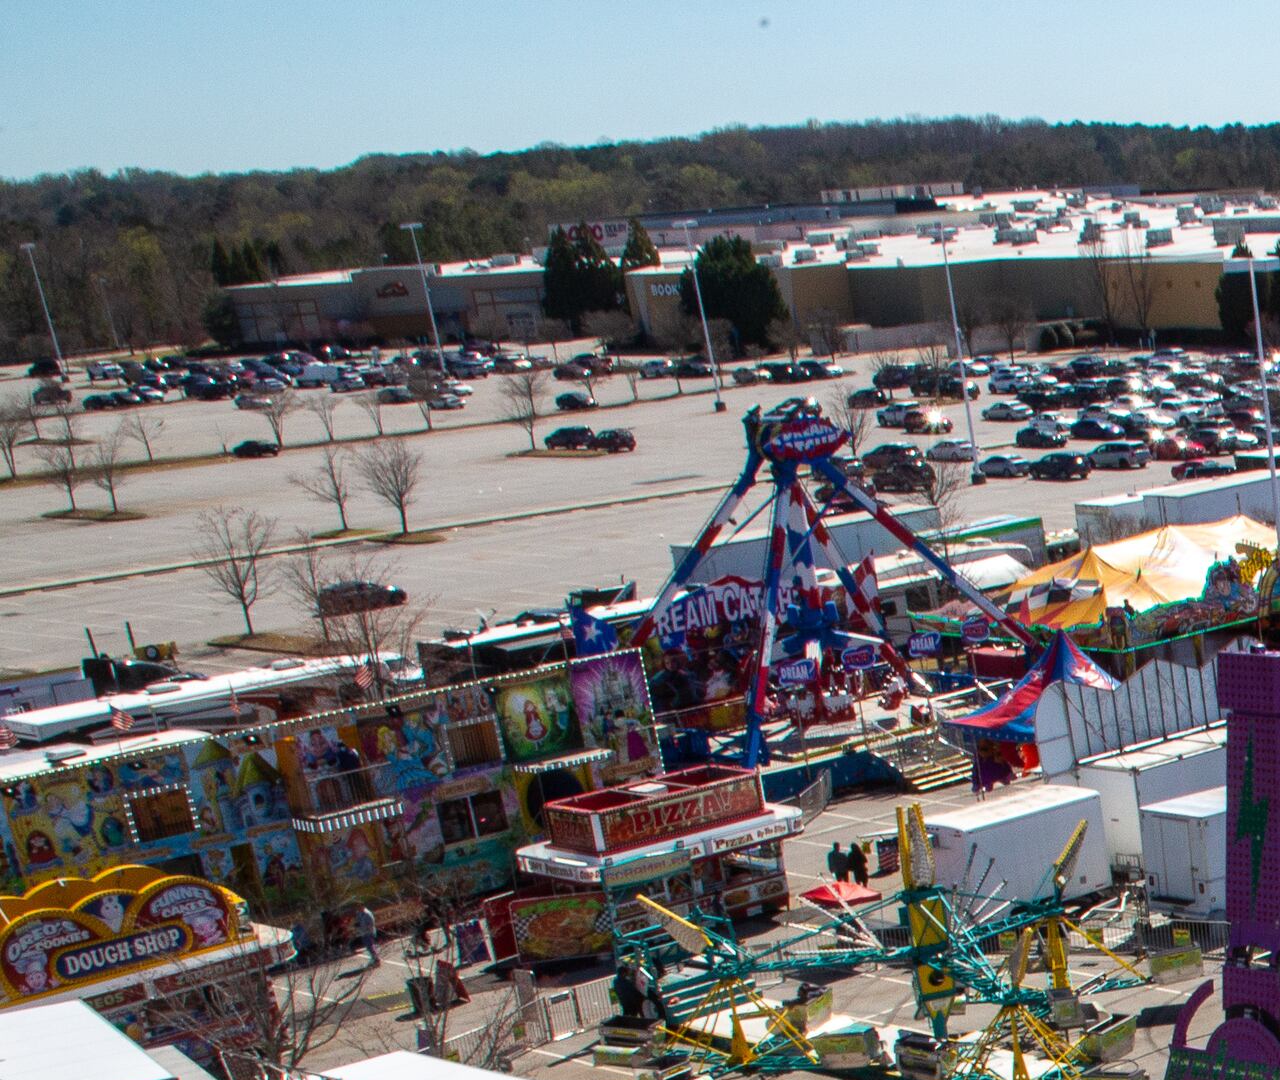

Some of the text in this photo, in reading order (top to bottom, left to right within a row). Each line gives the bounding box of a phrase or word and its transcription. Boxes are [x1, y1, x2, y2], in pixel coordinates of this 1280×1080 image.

[911, 635, 935, 651] DREAM
[780, 662, 809, 681] DREAM
[631, 791, 732, 833] PIZZA!
[150, 885, 217, 915] FUNNEL
[161, 900, 208, 918] CAKES
[65, 929, 181, 975] DOUGH SHOP
